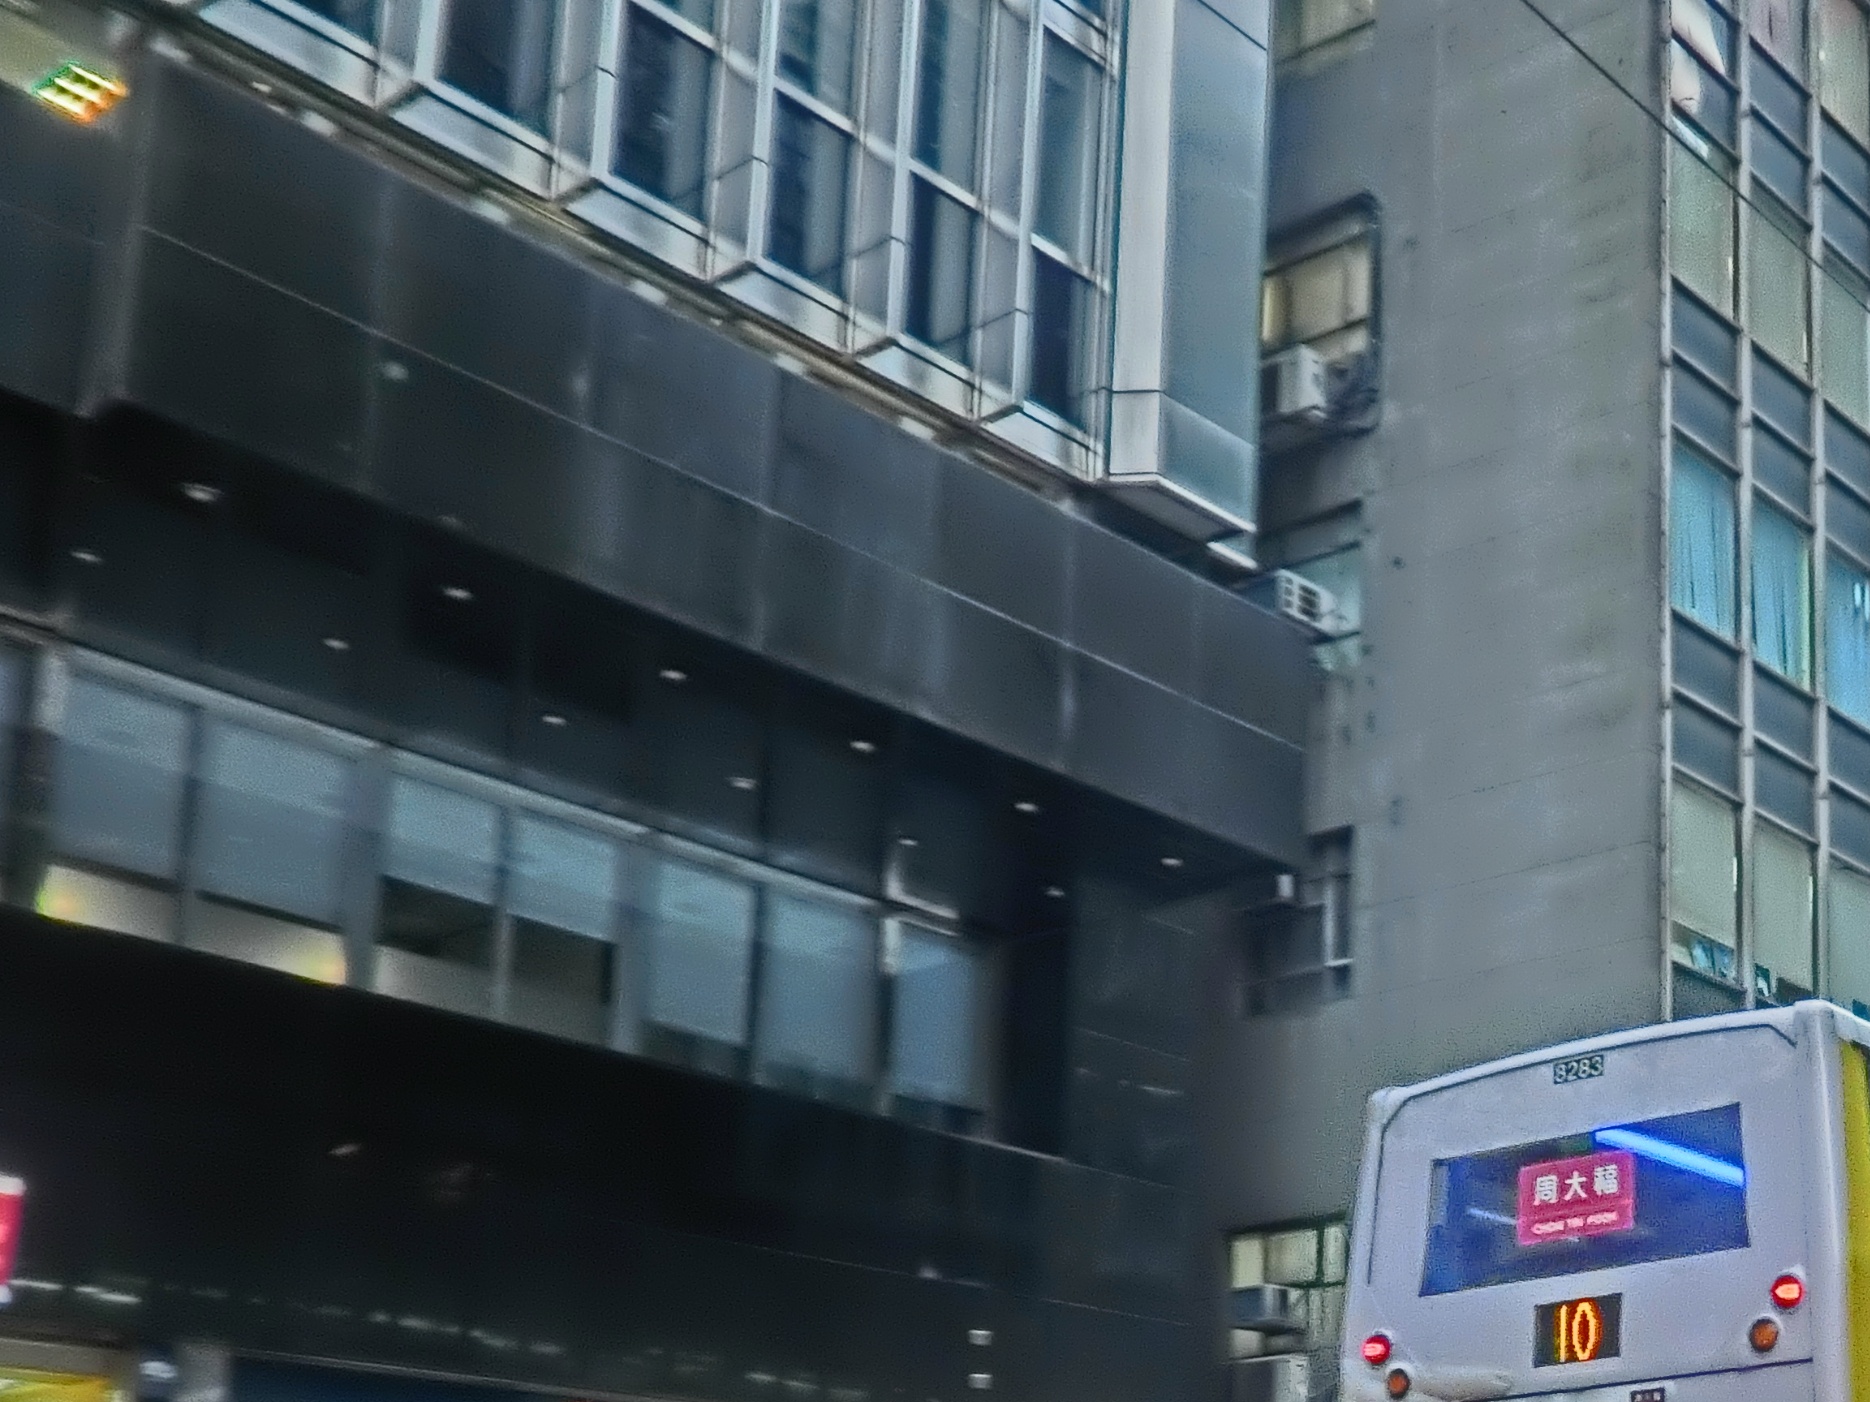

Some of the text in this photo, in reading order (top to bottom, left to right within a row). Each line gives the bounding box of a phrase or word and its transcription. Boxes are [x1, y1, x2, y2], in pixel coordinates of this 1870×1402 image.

[1554, 1056, 1604, 1083] 8283
[1533, 1163, 1619, 1205] 周大福
[1559, 1301, 1597, 1362] 10
